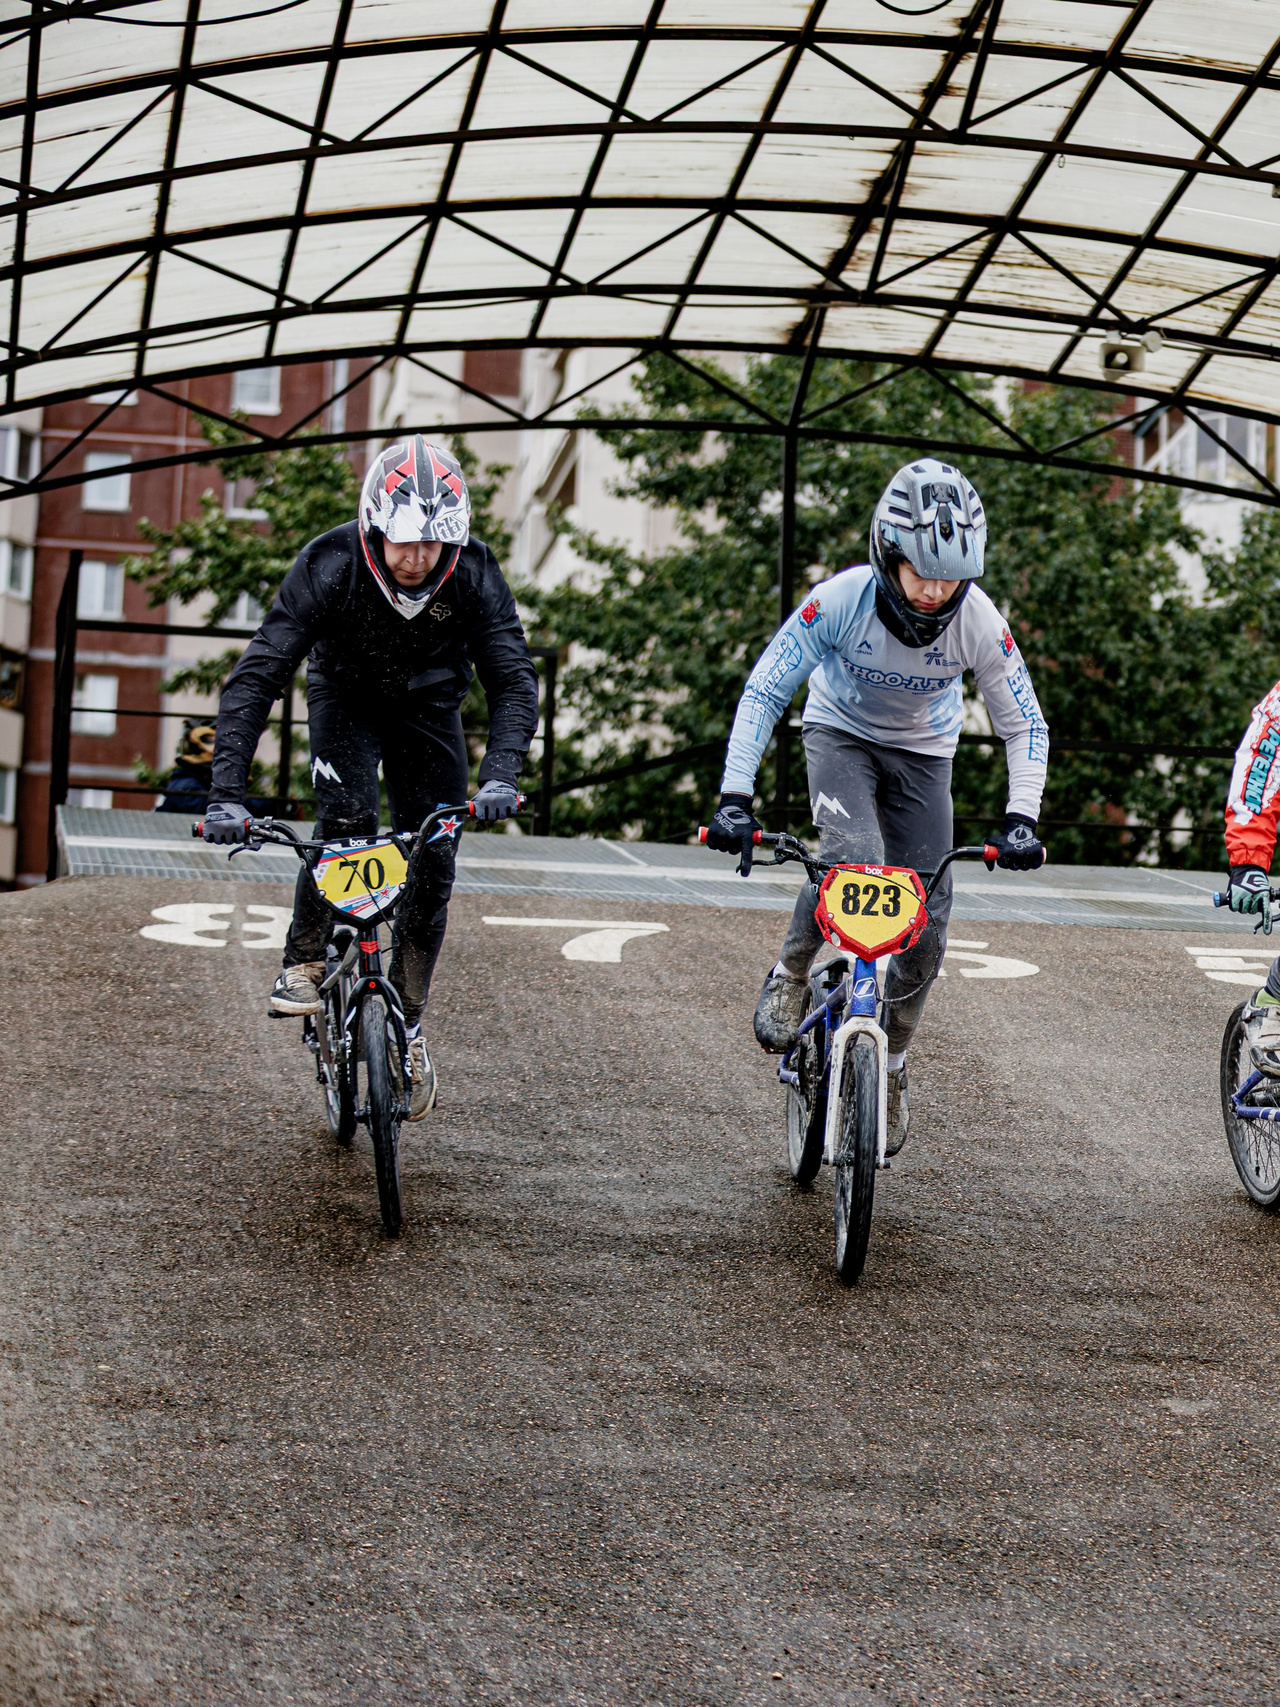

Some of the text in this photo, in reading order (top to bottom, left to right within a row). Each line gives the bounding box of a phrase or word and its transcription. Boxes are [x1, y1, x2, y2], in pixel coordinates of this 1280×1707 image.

[349, 838, 369, 847] box
[339, 857, 385, 893] 70
[865, 865, 883, 876] box
[841, 882, 901, 918] 823
[481, 916, 671, 963] 7
